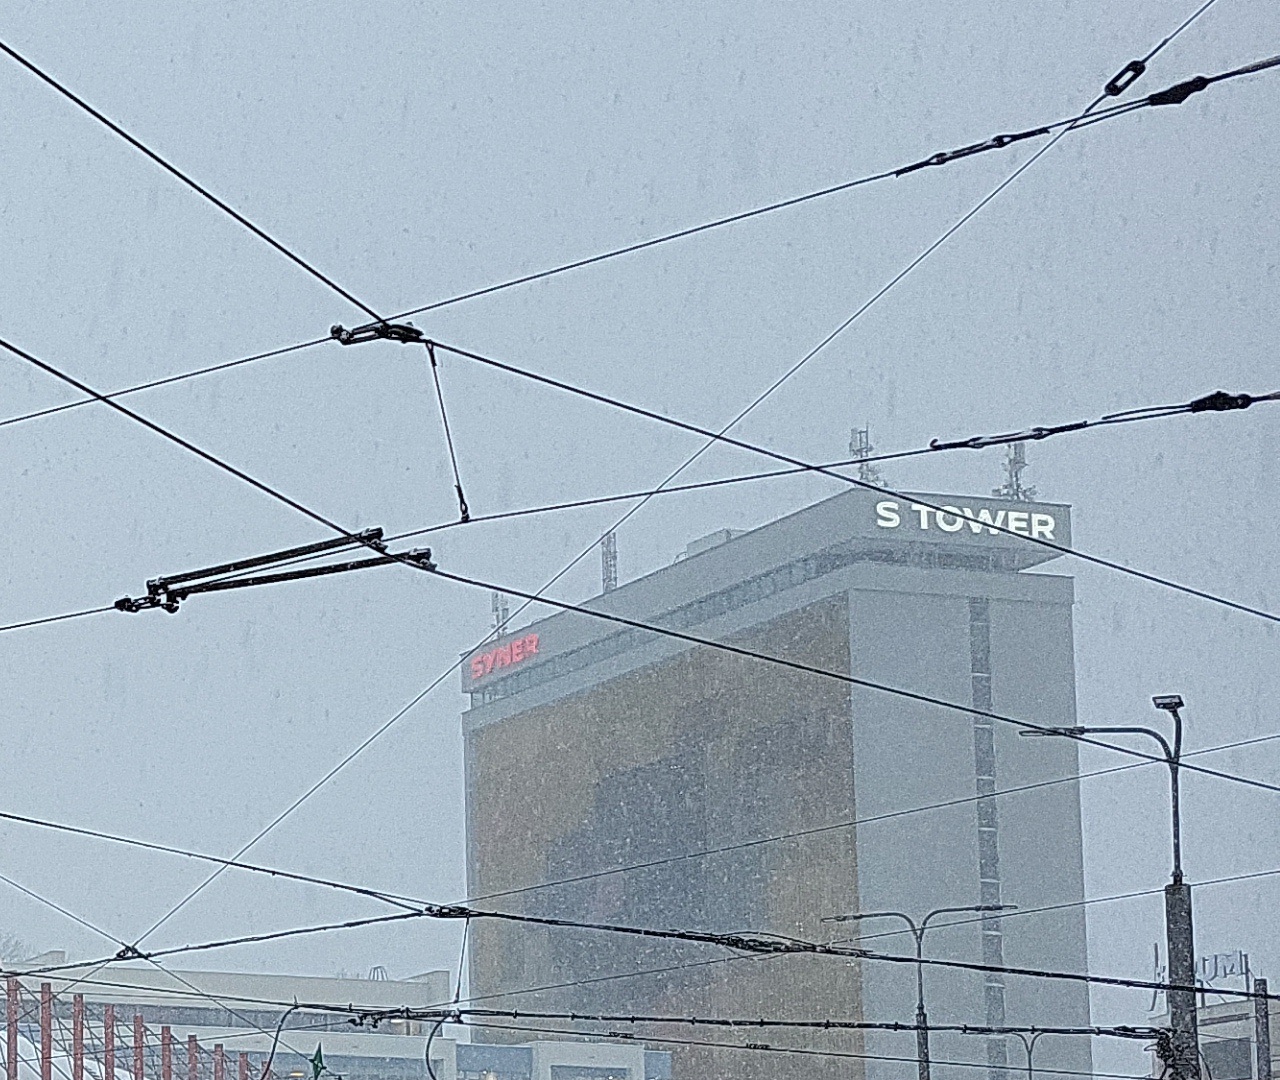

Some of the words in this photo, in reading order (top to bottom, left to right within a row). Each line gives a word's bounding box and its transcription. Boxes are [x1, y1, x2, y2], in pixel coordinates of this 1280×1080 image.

[876, 501, 901, 528] S
[911, 503, 1056, 540] TOWER
[471, 633, 539, 680] SYNER
